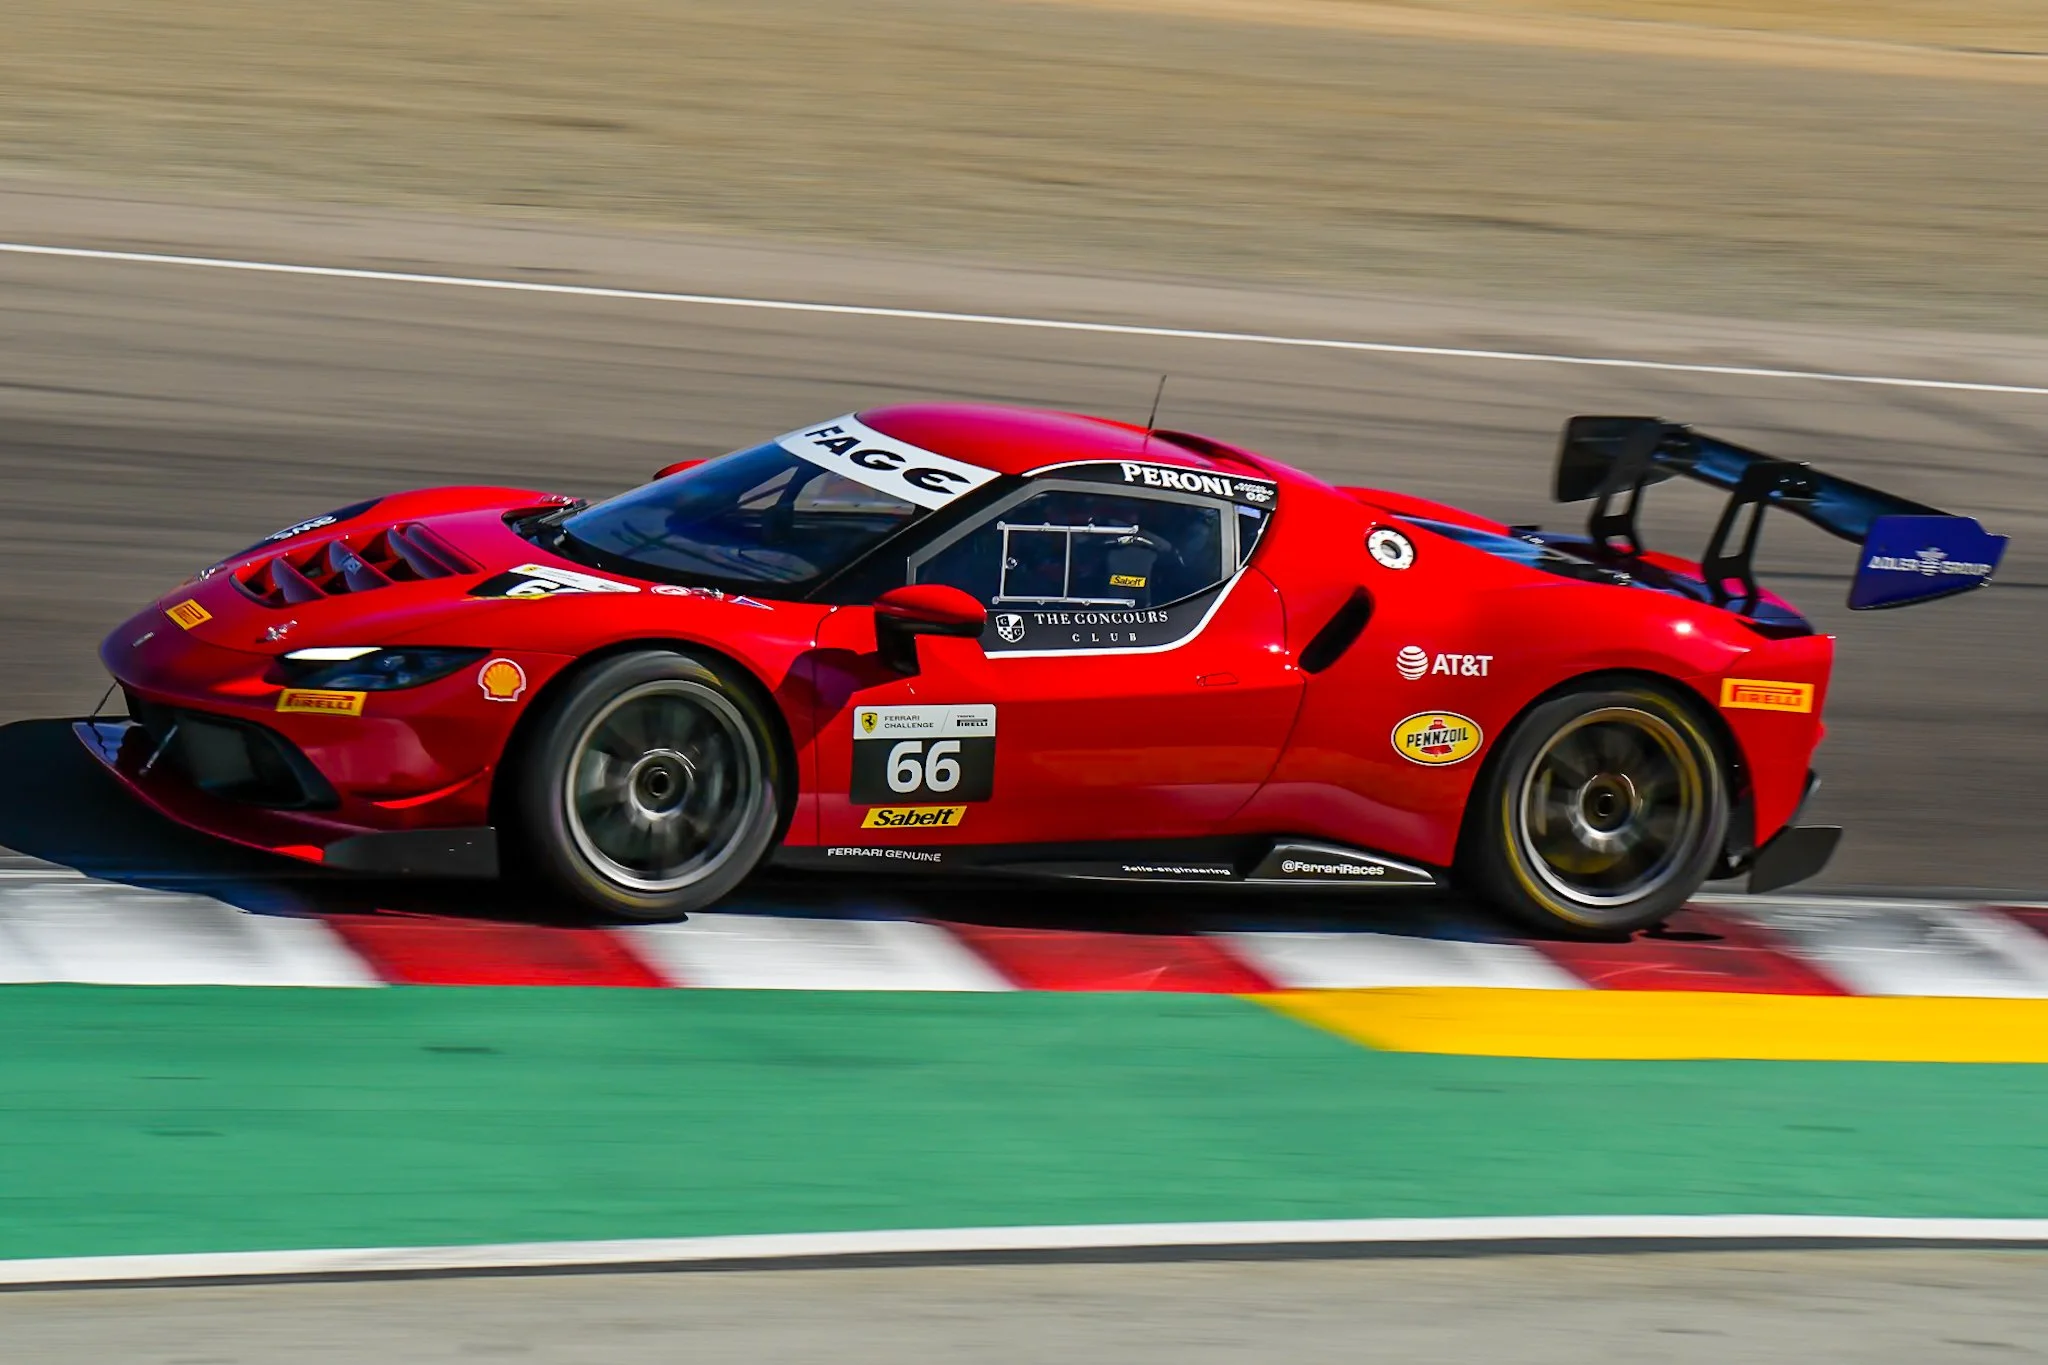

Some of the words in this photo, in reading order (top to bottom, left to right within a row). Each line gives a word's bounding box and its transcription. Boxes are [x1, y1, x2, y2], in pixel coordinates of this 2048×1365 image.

[1120, 462, 1235, 497] PERONI
[1867, 555, 1919, 572] ADLER
[1940, 560, 1993, 576] GROUP
[1034, 613, 1071, 626] THE
[1074, 610, 1170, 625] CONCOURS
[1431, 653, 1494, 677] AT&T
[286, 693, 356, 710] PIRELLI
[884, 714, 921, 722] FERRARI
[884, 721, 935, 729] CHALLENGE
[956, 718, 988, 727] PIRELLI
[1406, 732, 1470, 749] PENNZOIL
[887, 740, 961, 793] 66
[873, 808, 955, 827] Sabelt
[827, 848, 883, 857] FERRARI
[885, 850, 942, 863] GENUINE
[1281, 859, 1386, 876] @FerrariRaces
